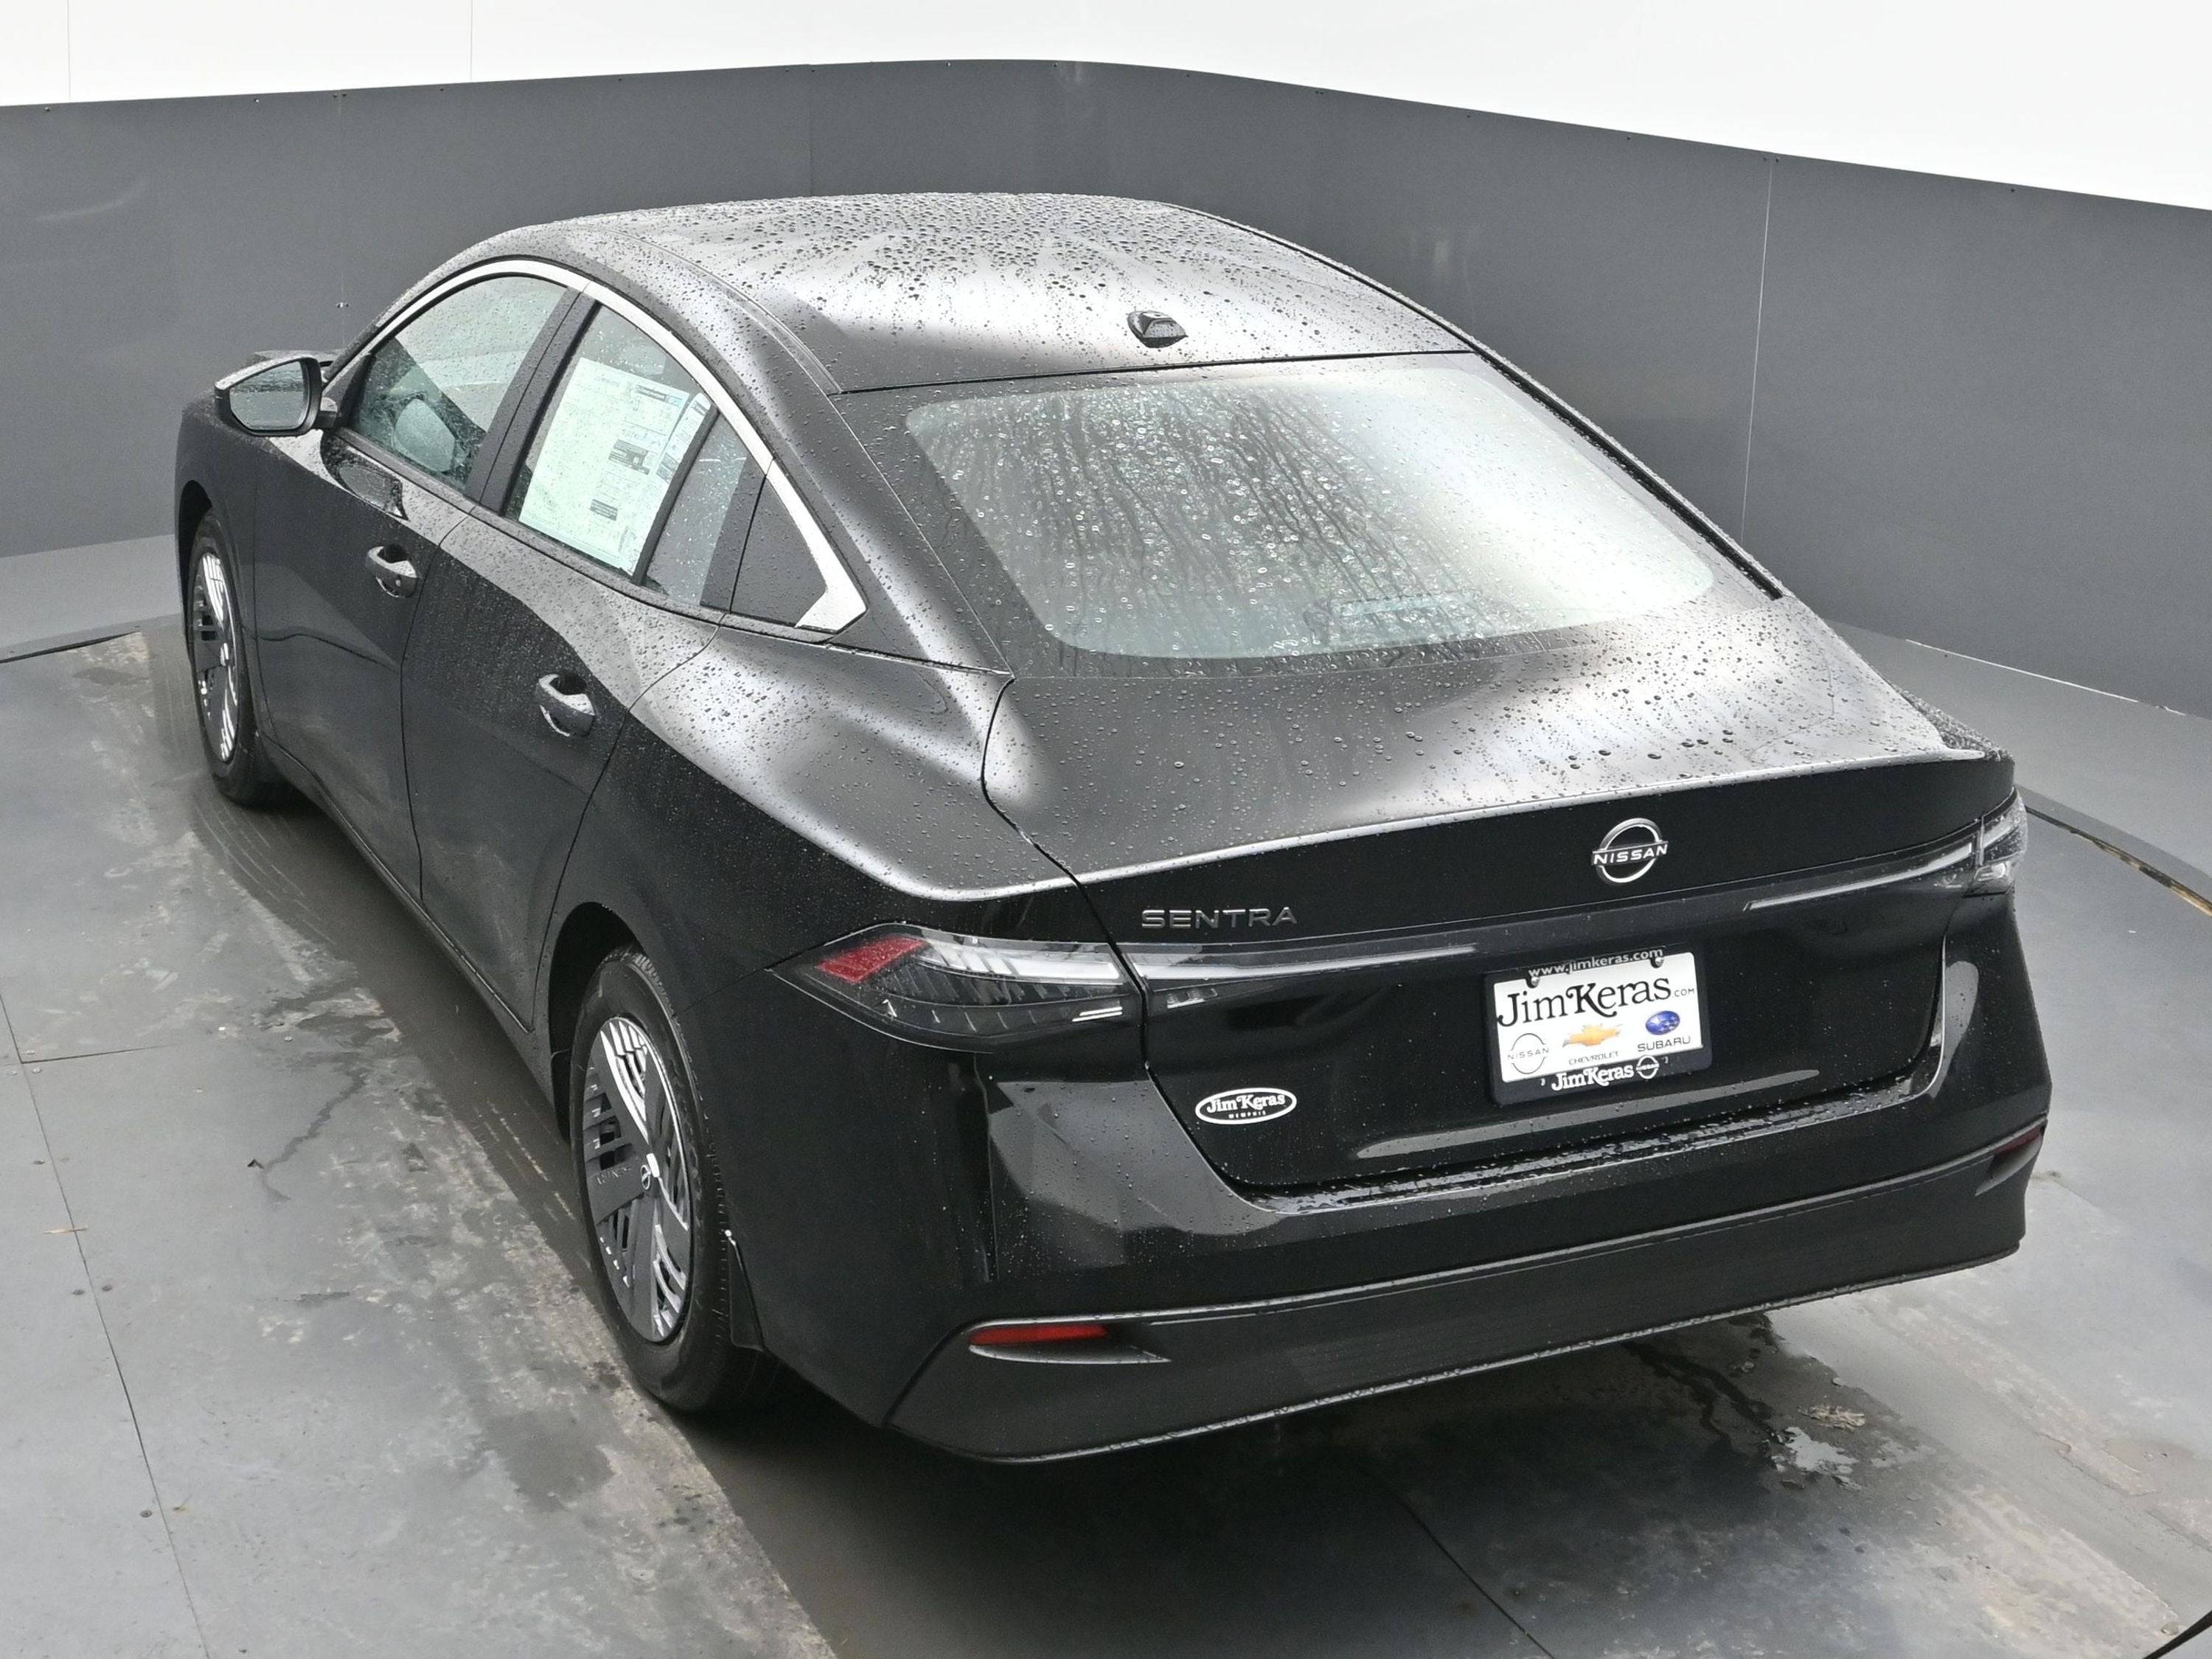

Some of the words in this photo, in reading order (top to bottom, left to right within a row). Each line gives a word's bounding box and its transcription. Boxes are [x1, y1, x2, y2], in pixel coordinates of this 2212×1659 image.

[1593, 844, 1668, 865] NISSAN
[1142, 907, 1298, 929] SENTRA
[1528, 948, 1663, 974] www.jimkeras.com
[1638, 1036, 1691, 1052] SUBARU
[1507, 1047, 1549, 1060] NISSAN
[1568, 1051, 1619, 1065] CHEVROLET
